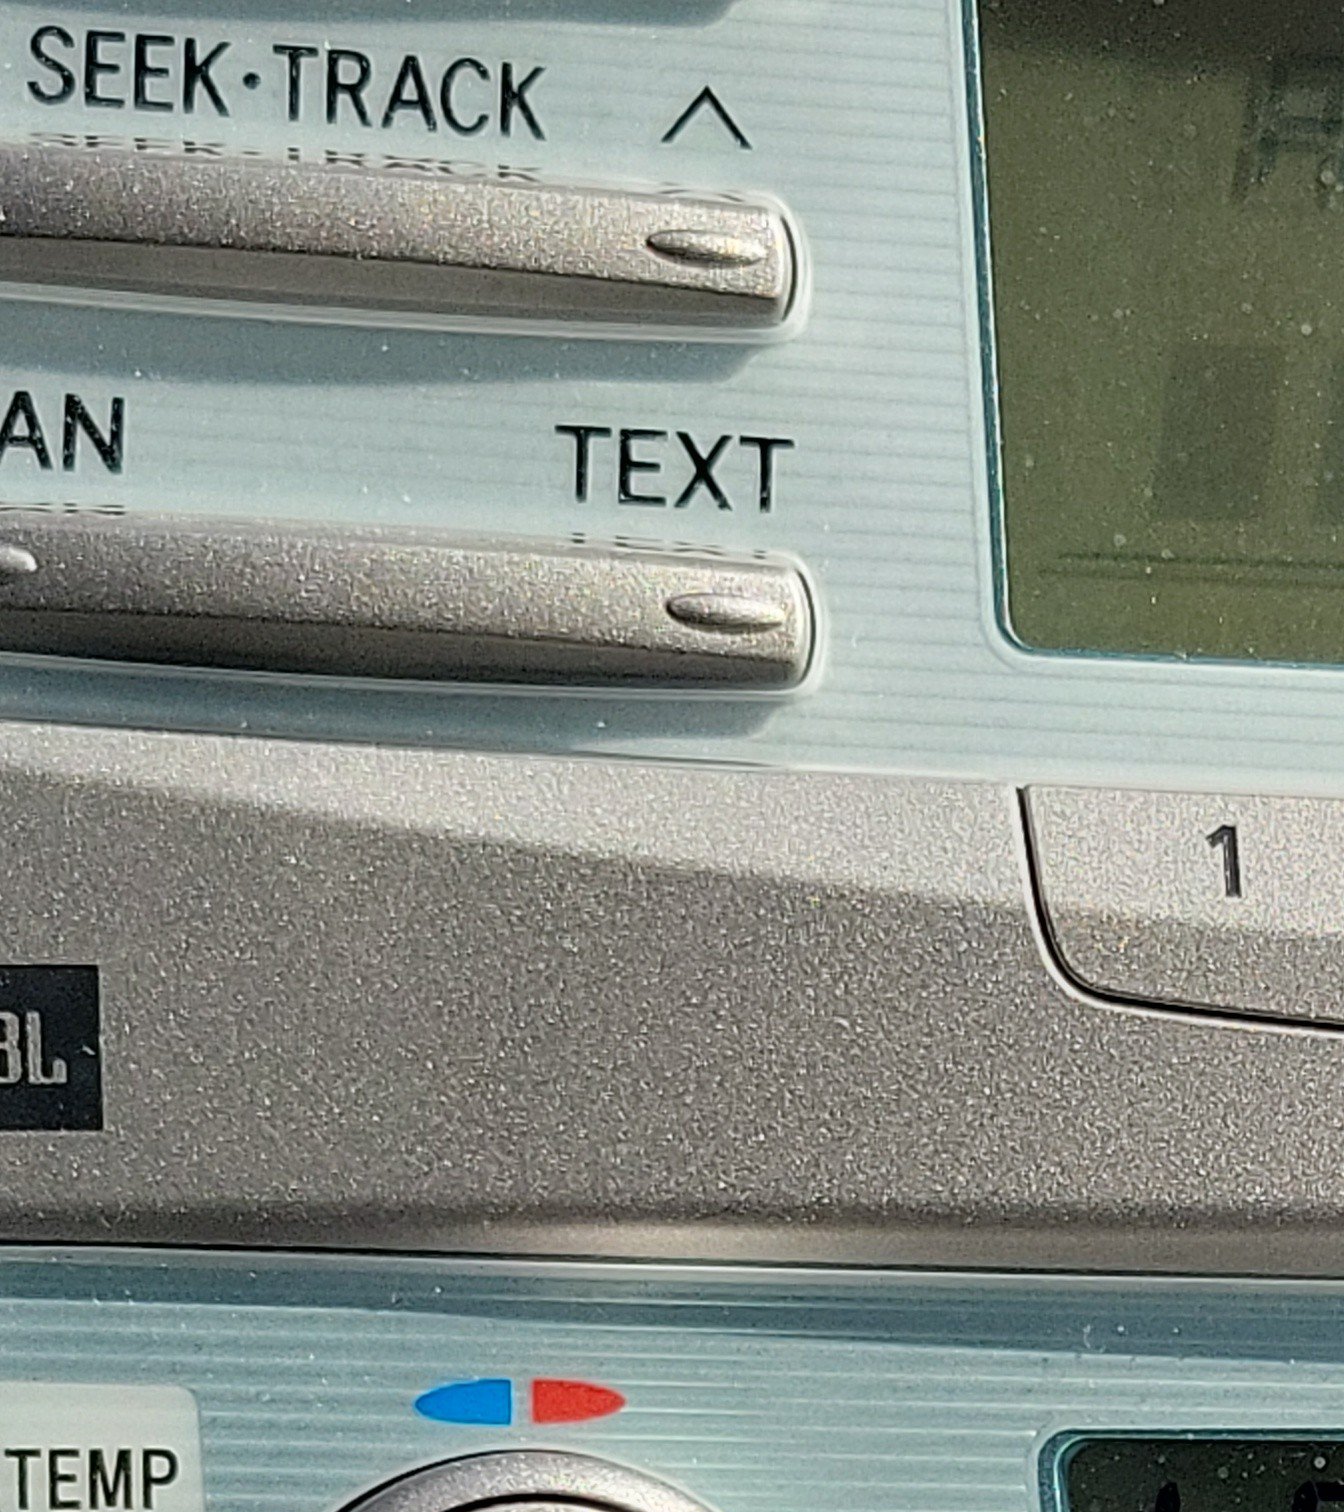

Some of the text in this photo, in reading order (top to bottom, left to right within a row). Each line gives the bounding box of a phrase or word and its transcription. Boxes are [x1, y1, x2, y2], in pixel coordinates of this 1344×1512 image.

[0, 390, 125, 475] AN
[555, 424, 796, 513] TEXT
[1204, 825, 1243, 898] 1
[4, 1447, 179, 1511] TEMP
